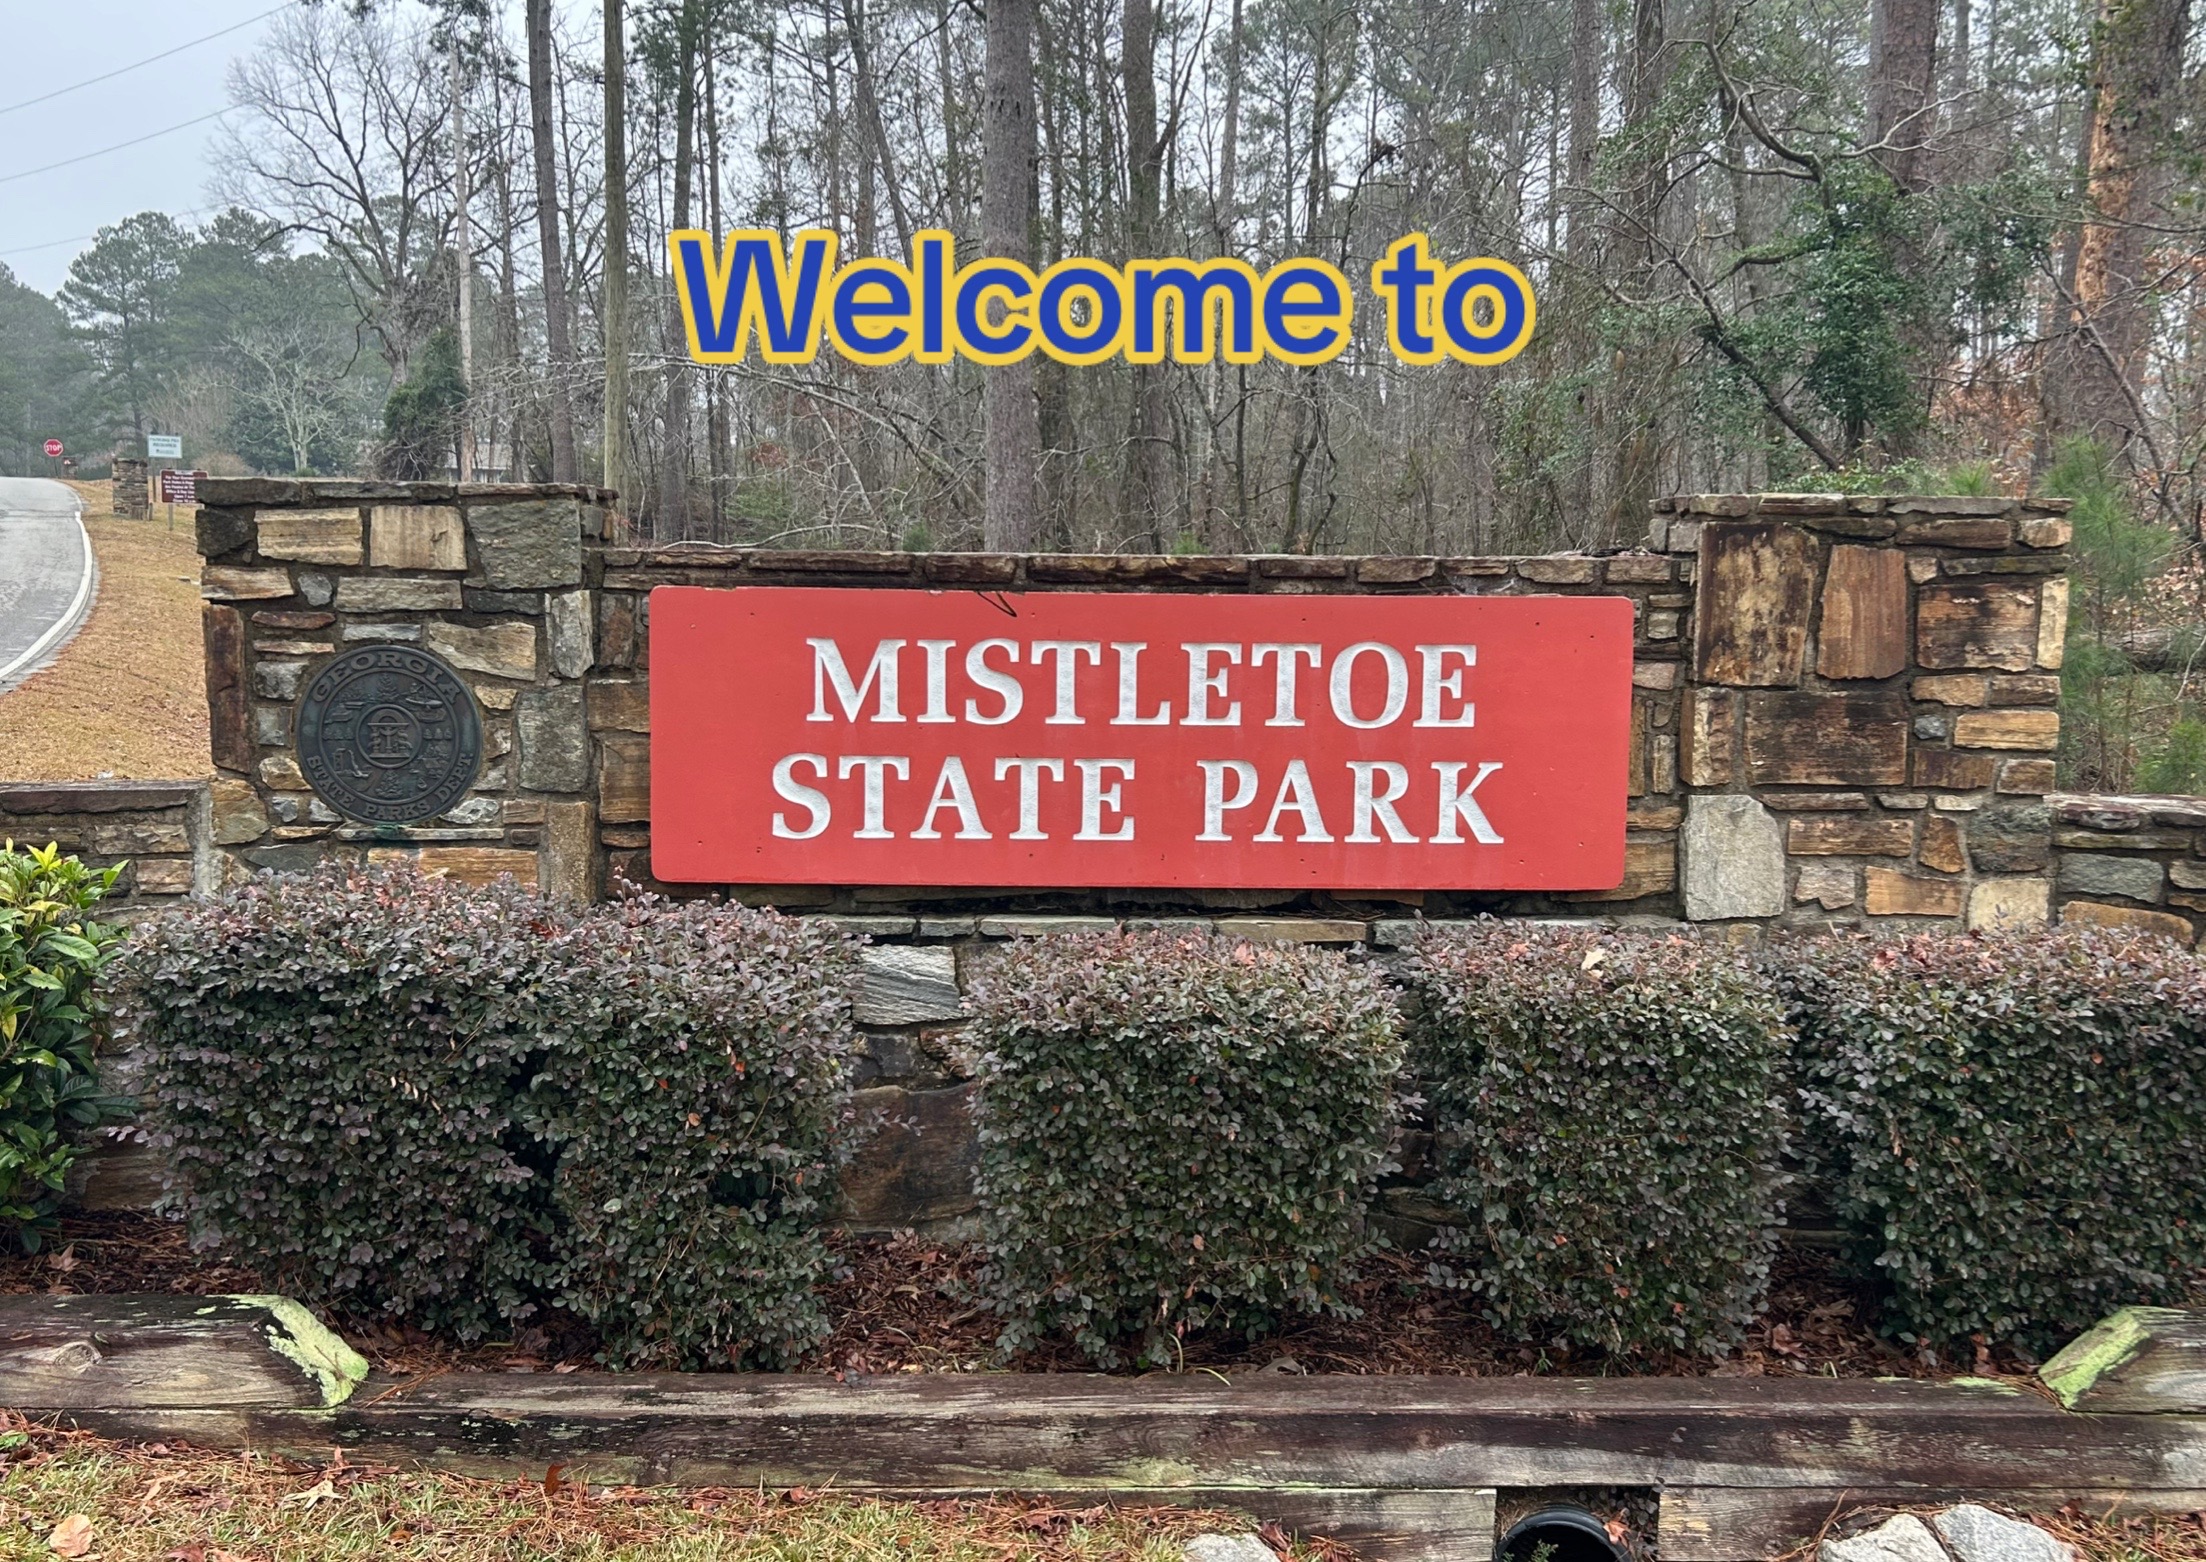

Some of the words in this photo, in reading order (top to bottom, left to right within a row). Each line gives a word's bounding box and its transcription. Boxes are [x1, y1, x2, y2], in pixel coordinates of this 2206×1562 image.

[312, 651, 462, 703] GEORGIA
[805, 637, 1477, 729] MISTLETOE
[307, 755, 355, 808] STATE
[364, 801, 432, 821] PARKS
[435, 752, 475, 803] DEPT.
[772, 753, 1136, 842] STATE
[1195, 759, 1505, 845] PARK
